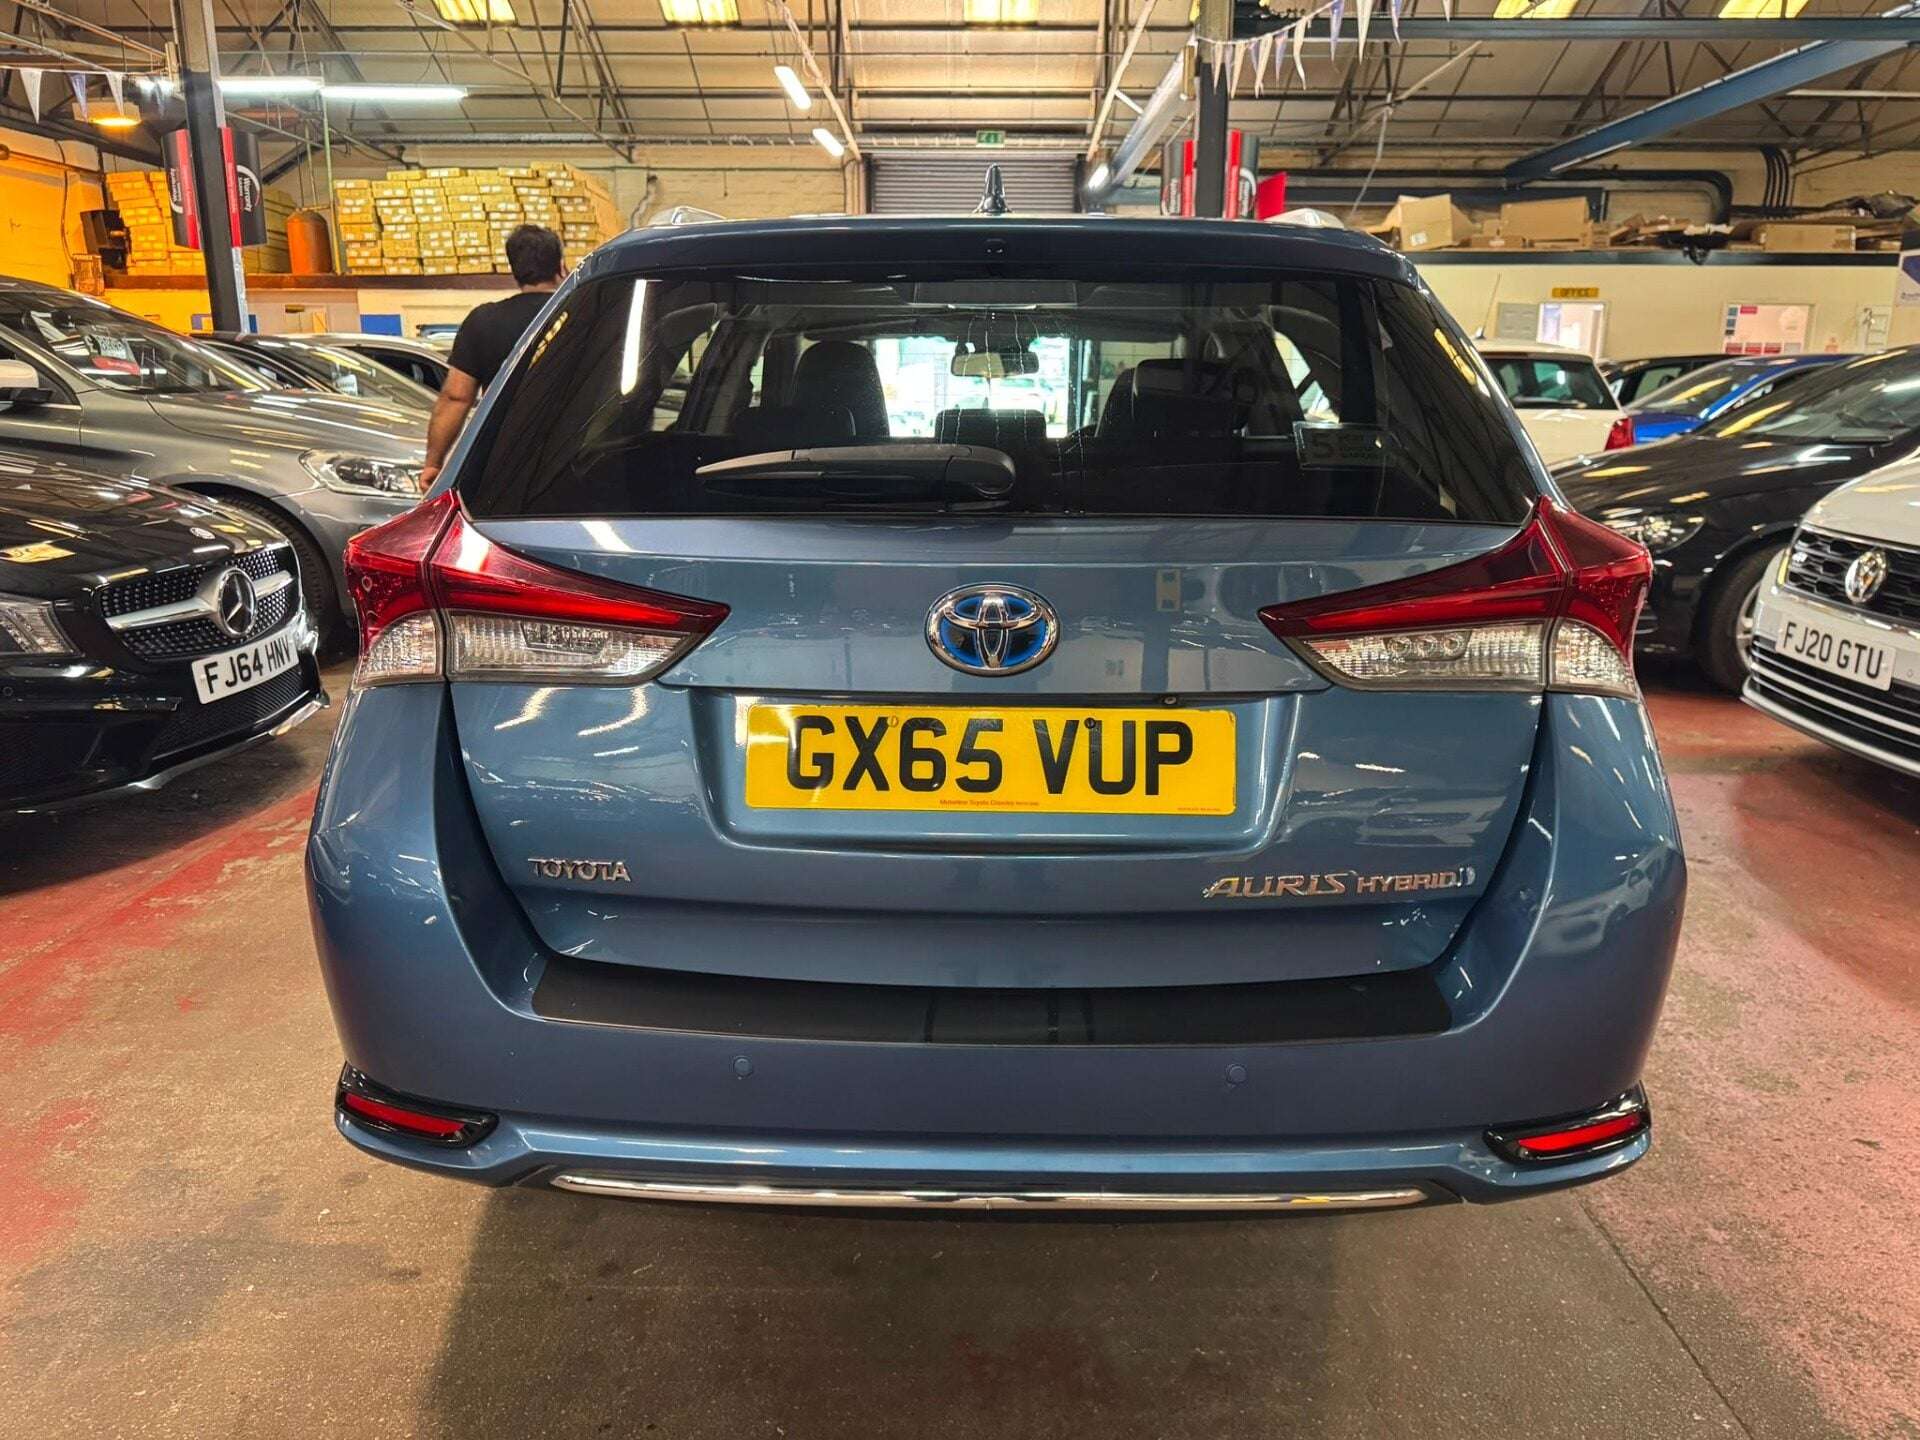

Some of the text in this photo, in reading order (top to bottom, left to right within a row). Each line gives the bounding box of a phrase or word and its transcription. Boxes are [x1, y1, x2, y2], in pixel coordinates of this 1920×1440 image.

[243, 177, 253, 213] Warranty
[1559, 288, 1593, 298] OFFICE
[1783, 621, 1884, 679] FJ20 GTU
[203, 647, 263, 694] FJ64
[786, 714, 1194, 796] GX65 VUP
[527, 858, 632, 882] TOYOTA
[1203, 870, 1460, 898] AURIS HYBRID
